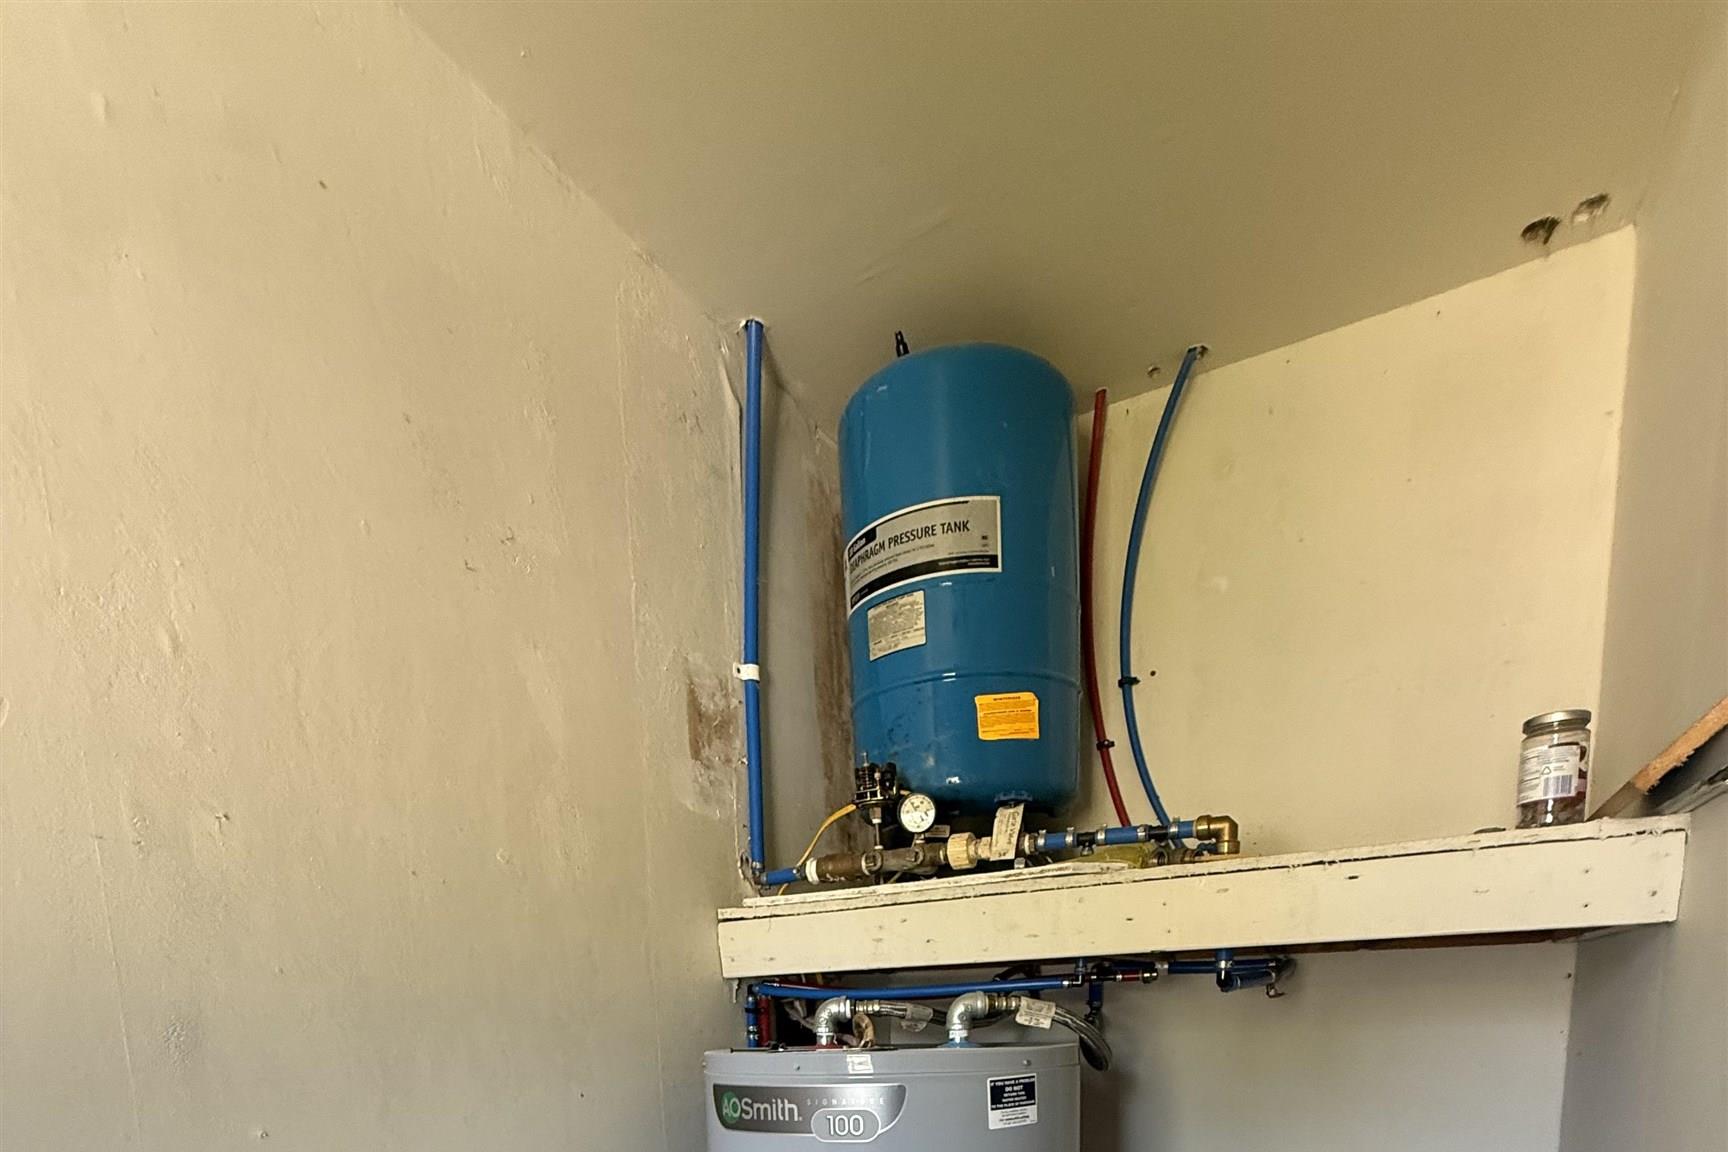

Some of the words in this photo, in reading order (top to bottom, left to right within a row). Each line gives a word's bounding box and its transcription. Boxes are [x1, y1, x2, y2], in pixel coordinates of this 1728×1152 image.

[888, 526, 937, 550] PRESSURE
[940, 520, 970, 534] TANK
[807, 1098, 884, 1106] SIGNATE
[826, 1114, 864, 1136] 100
